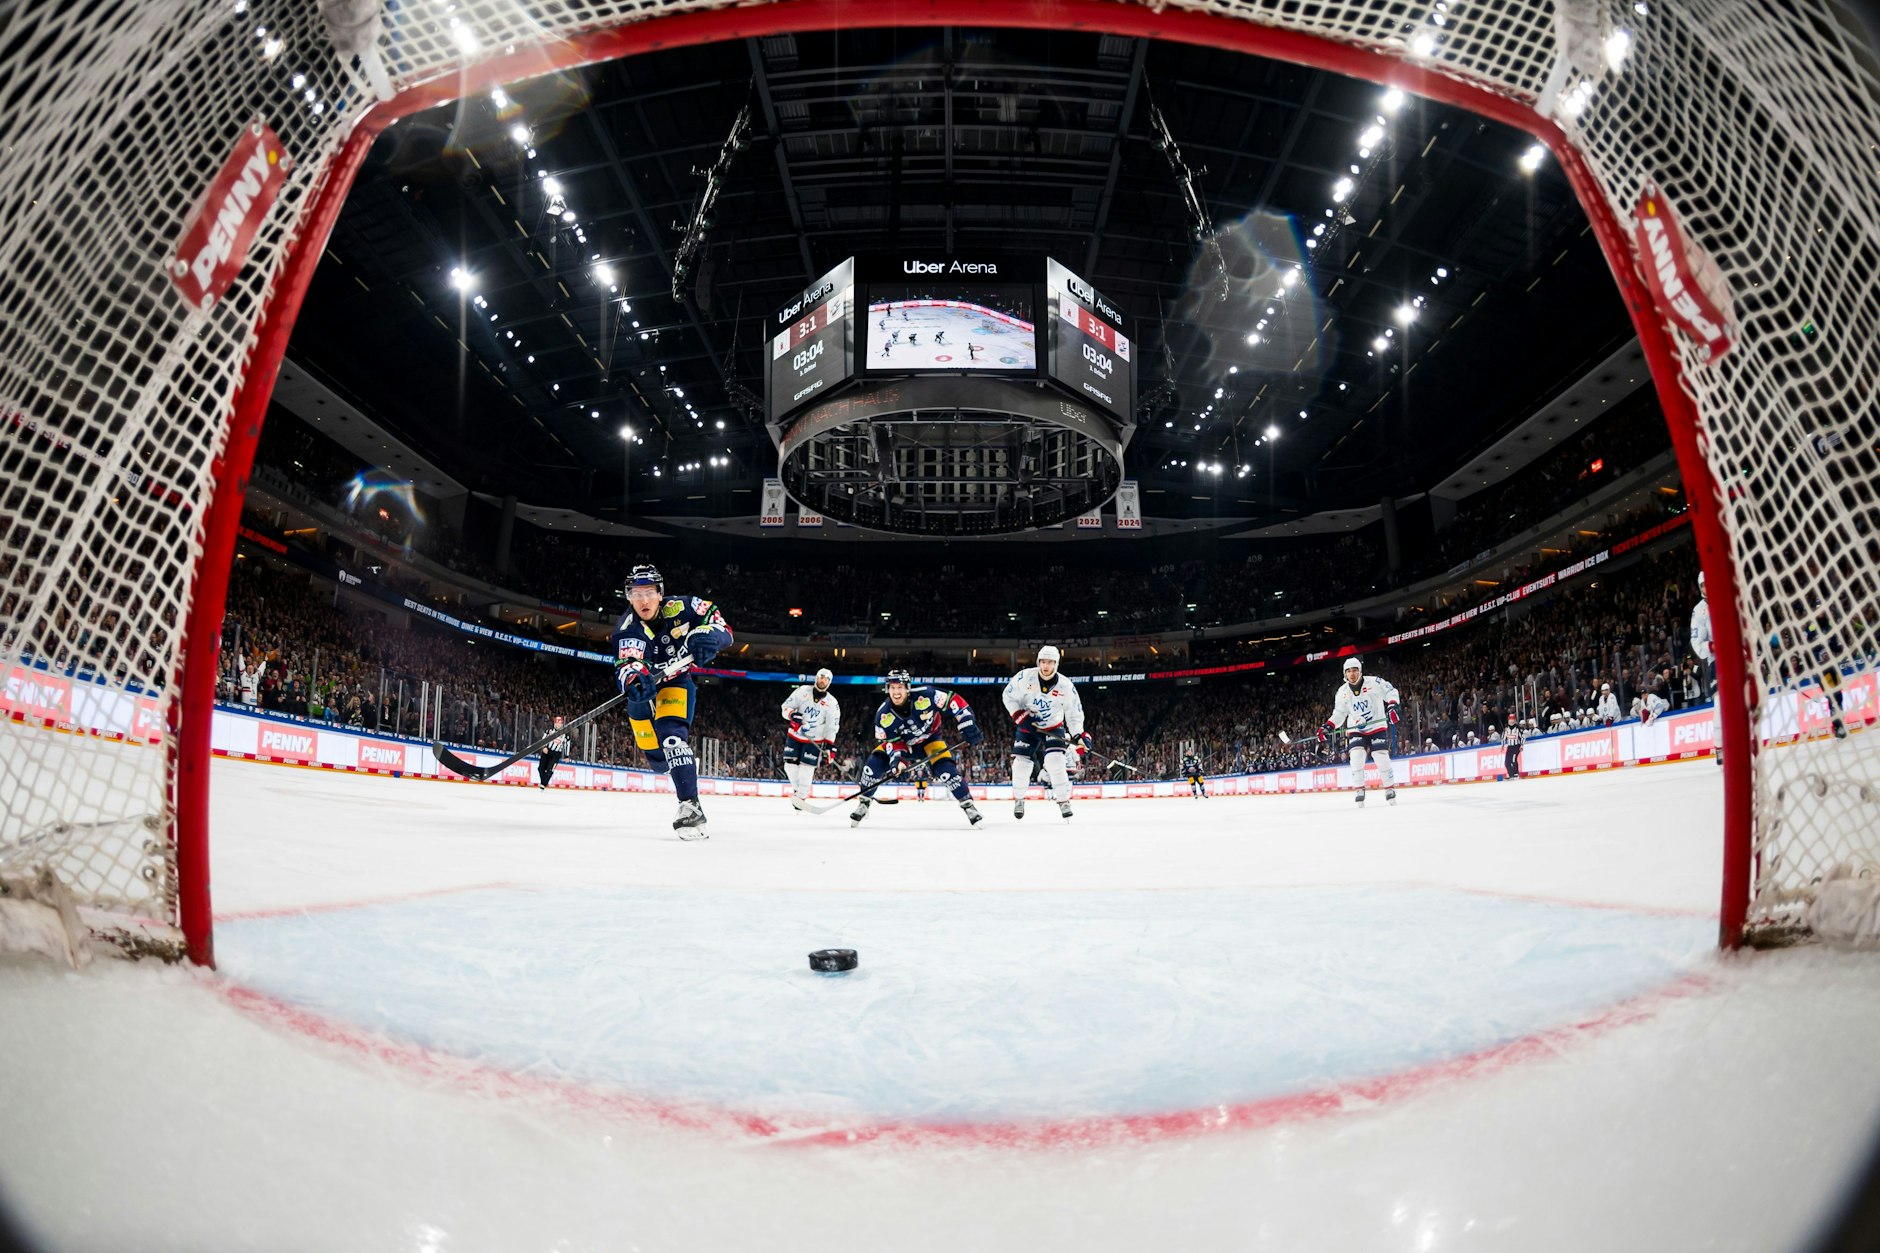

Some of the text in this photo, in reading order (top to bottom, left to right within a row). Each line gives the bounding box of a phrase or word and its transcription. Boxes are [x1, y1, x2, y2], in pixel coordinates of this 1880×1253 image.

[903, 260, 998, 274] Uber Arena
[778, 281, 833, 324] Uber Arena
[1068, 278, 1123, 326] Uber Arena
[799, 315, 817, 339] 3:1
[1088, 317, 1106, 342] 3:1
[793, 339, 824, 371] 03:04
[1082, 343, 1113, 375] 03:04
[793, 379, 824, 401] GASAG
[1083, 382, 1112, 404] GASAG
[762, 516, 783, 524] 2005
[800, 516, 821, 524] 2006
[1387, 634, 1401, 645] BEST
[1401, 629, 1418, 641] SEATS
[1424, 624, 1435, 634] THE
[1465, 607, 1479, 619] VIEW
[1496, 589, 1521, 607] VIP-CLUB
[1522, 573, 1556, 596] EVENTSUITE
[1557, 560, 1585, 580] WARRIOR
[1584, 555, 1596, 569] ICE
[1595, 549, 1609, 564] BOX
[404, 598, 417, 610] BEST
[416, 603, 432, 616] SEATS
[460, 621, 474, 632] DINE
[479, 627, 493, 637] VIEW
[512, 636, 539, 649] VIP-CLUB
[540, 643, 576, 657] EVENTSUITE
[603, 654, 614, 663] ICE
[619, 648, 644, 659] MOLY
[620, 641, 646, 649] LIQUI
[1092, 674, 1121, 682] WARRIOR
[1121, 673, 1132, 681] ICE
[1132, 673, 1146, 681] BOX
[1674, 719, 1715, 746] PENN
[668, 757, 693, 769] ERLIN
[1480, 754, 1505, 770] PEN
